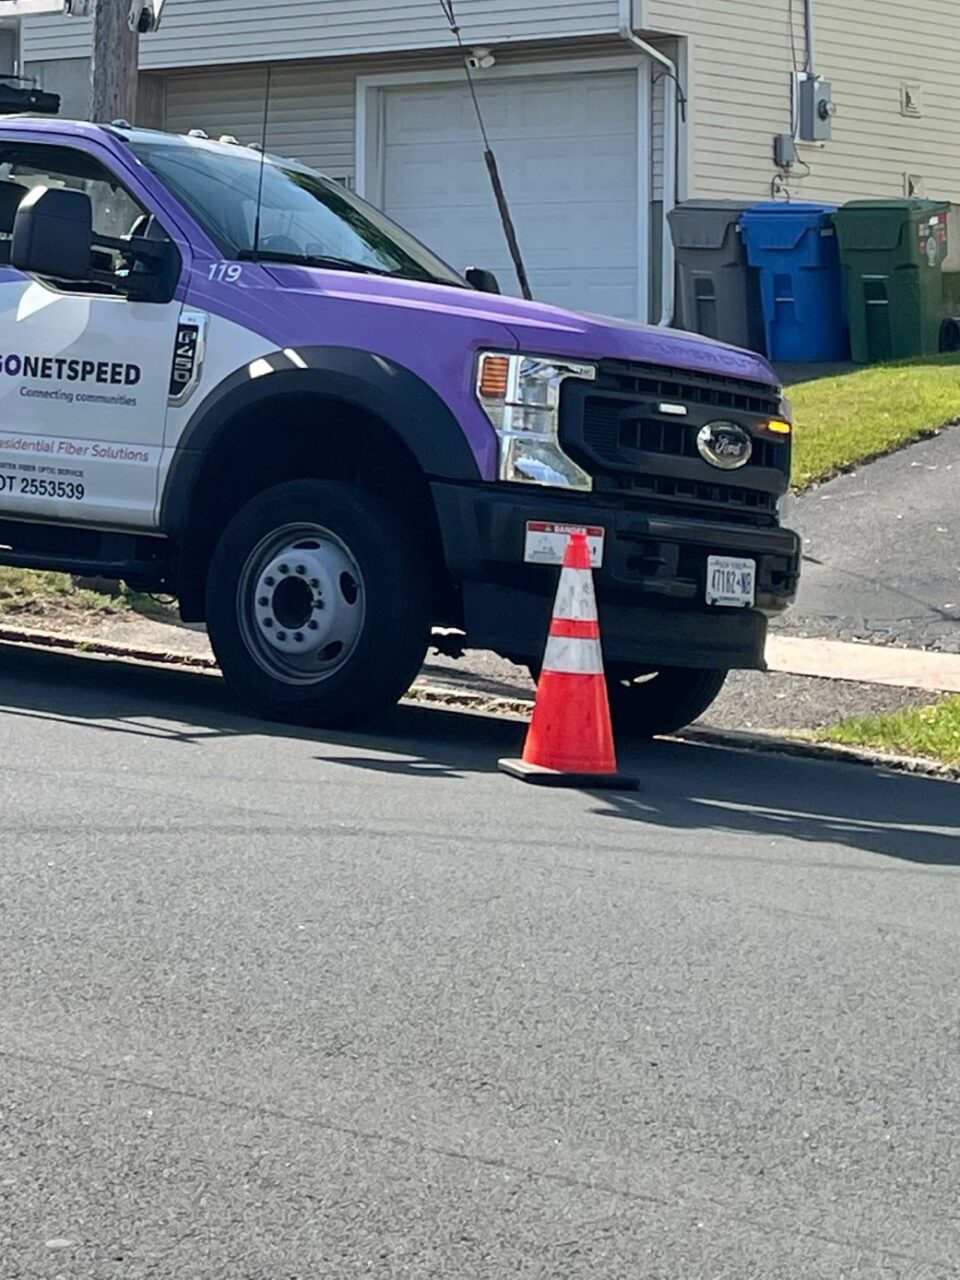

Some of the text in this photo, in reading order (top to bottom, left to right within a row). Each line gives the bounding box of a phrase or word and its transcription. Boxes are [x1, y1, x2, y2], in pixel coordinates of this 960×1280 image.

[208, 263, 242, 282] 119
[20, 386, 137, 406] Connecting communities
[57, 441, 90, 457] Fiber
[91, 444, 149, 463] Solutions
[20, 477, 85, 501] 2553539
